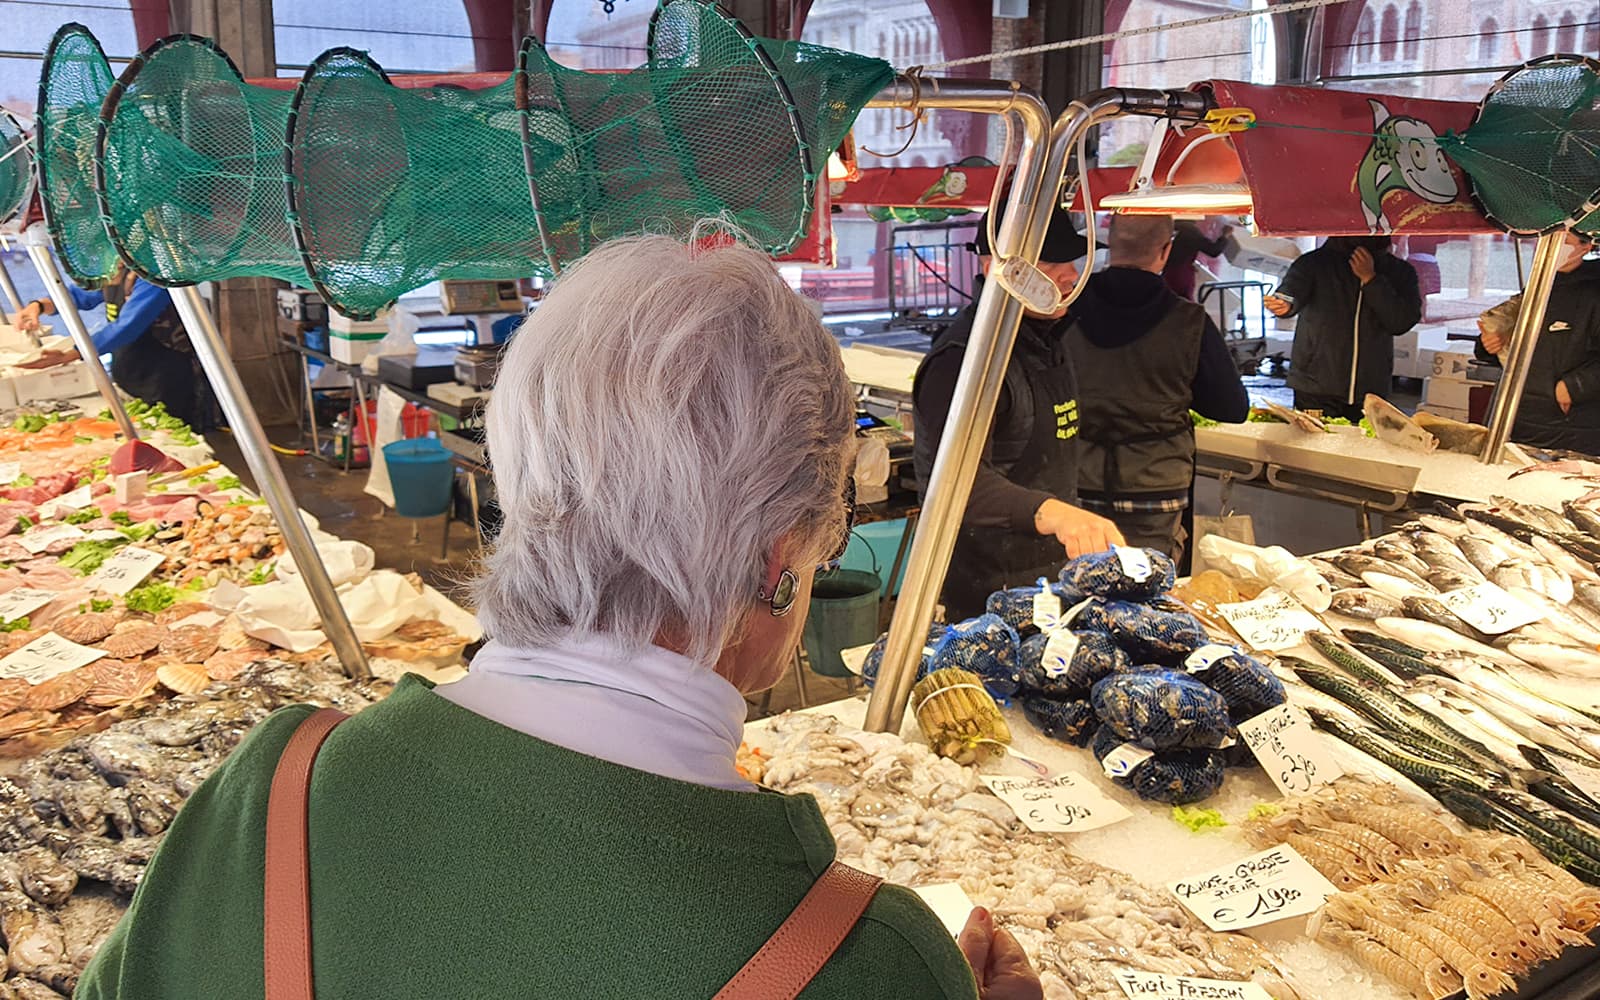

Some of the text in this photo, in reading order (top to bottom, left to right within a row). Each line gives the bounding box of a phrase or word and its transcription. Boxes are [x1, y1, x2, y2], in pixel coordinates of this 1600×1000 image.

[1028, 808, 1045, 823] €
[1235, 851, 1290, 879] GROSSE
[1212, 907, 1238, 924] €
